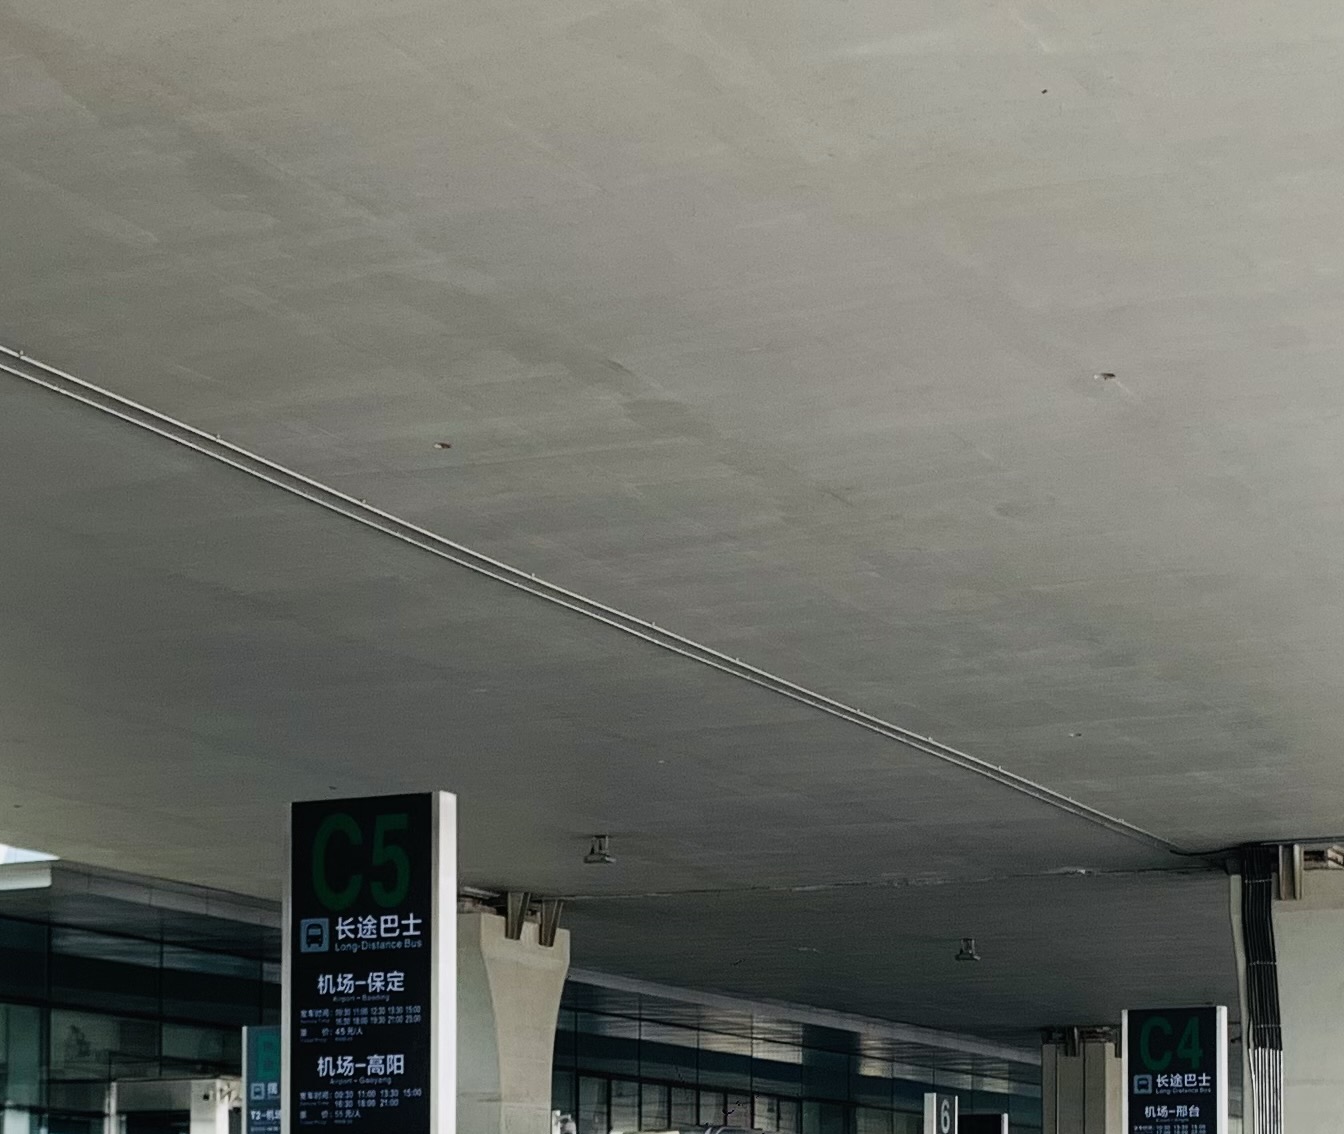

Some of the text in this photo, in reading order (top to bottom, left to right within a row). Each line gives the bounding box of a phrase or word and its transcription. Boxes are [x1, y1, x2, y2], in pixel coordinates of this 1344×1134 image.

[312, 813, 412, 911] C5
[335, 913, 423, 940] 长途巴士
[404, 938, 423, 949] Bus
[1140, 1016, 1203, 1072] C4
[403, 1088, 422, 1097] 15:00
[1156, 1073, 1212, 1088] 长途巴士
[940, 1099, 951, 1134] 6
